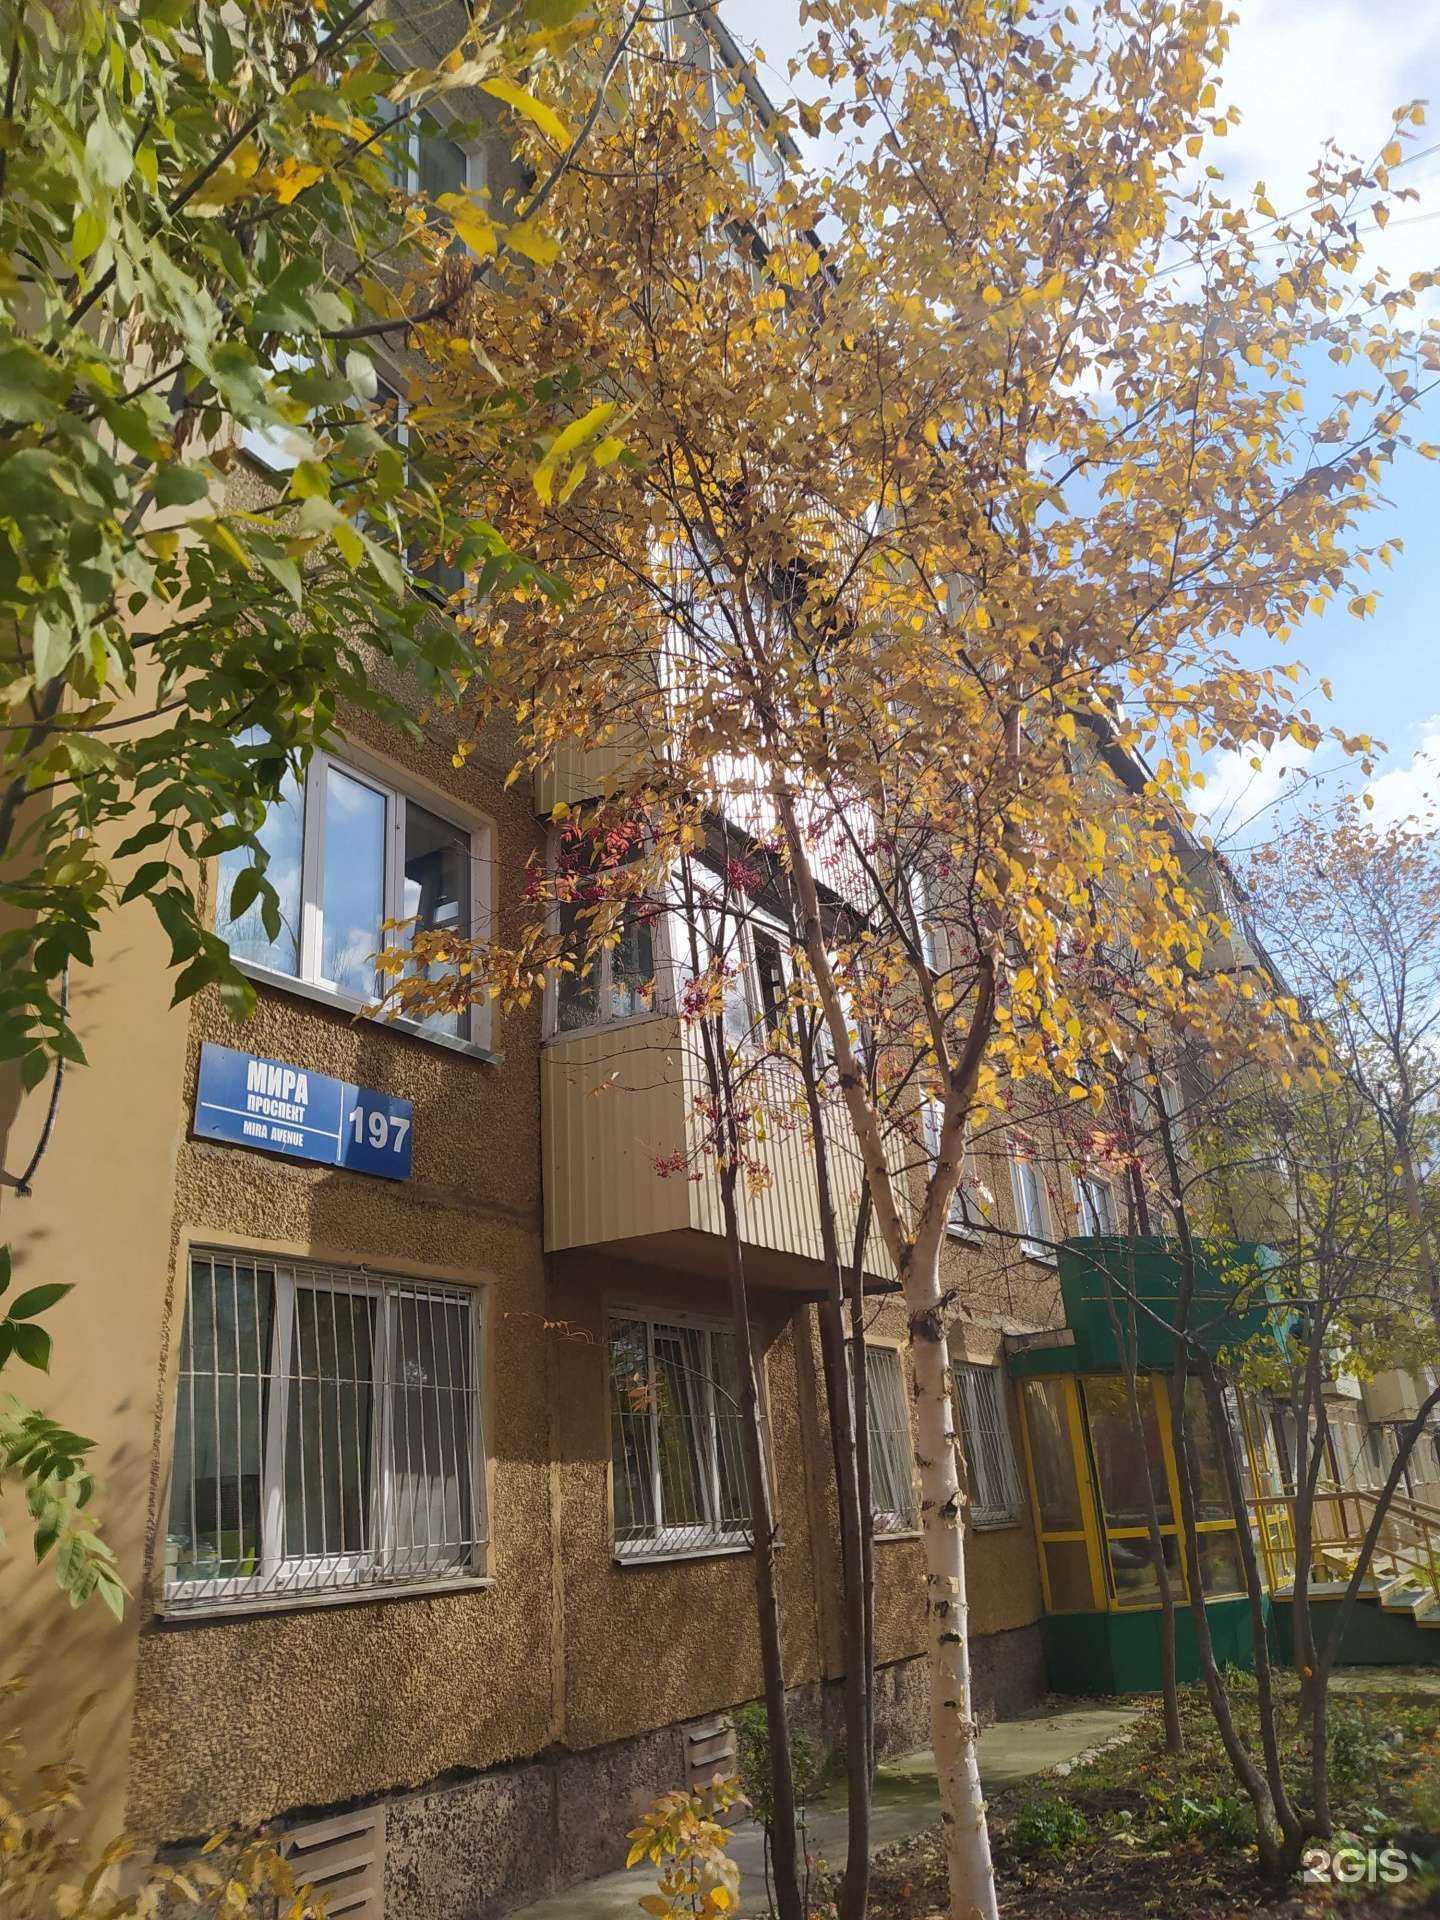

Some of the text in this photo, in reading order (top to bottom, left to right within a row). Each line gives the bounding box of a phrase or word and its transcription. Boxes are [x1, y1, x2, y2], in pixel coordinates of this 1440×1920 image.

[247, 1060, 308, 1105] МИРА
[247, 1094, 305, 1123] ПРОСПЕКТ
[243, 1120, 304, 1147] MIRA AVENUE
[349, 1106, 410, 1152] 197
